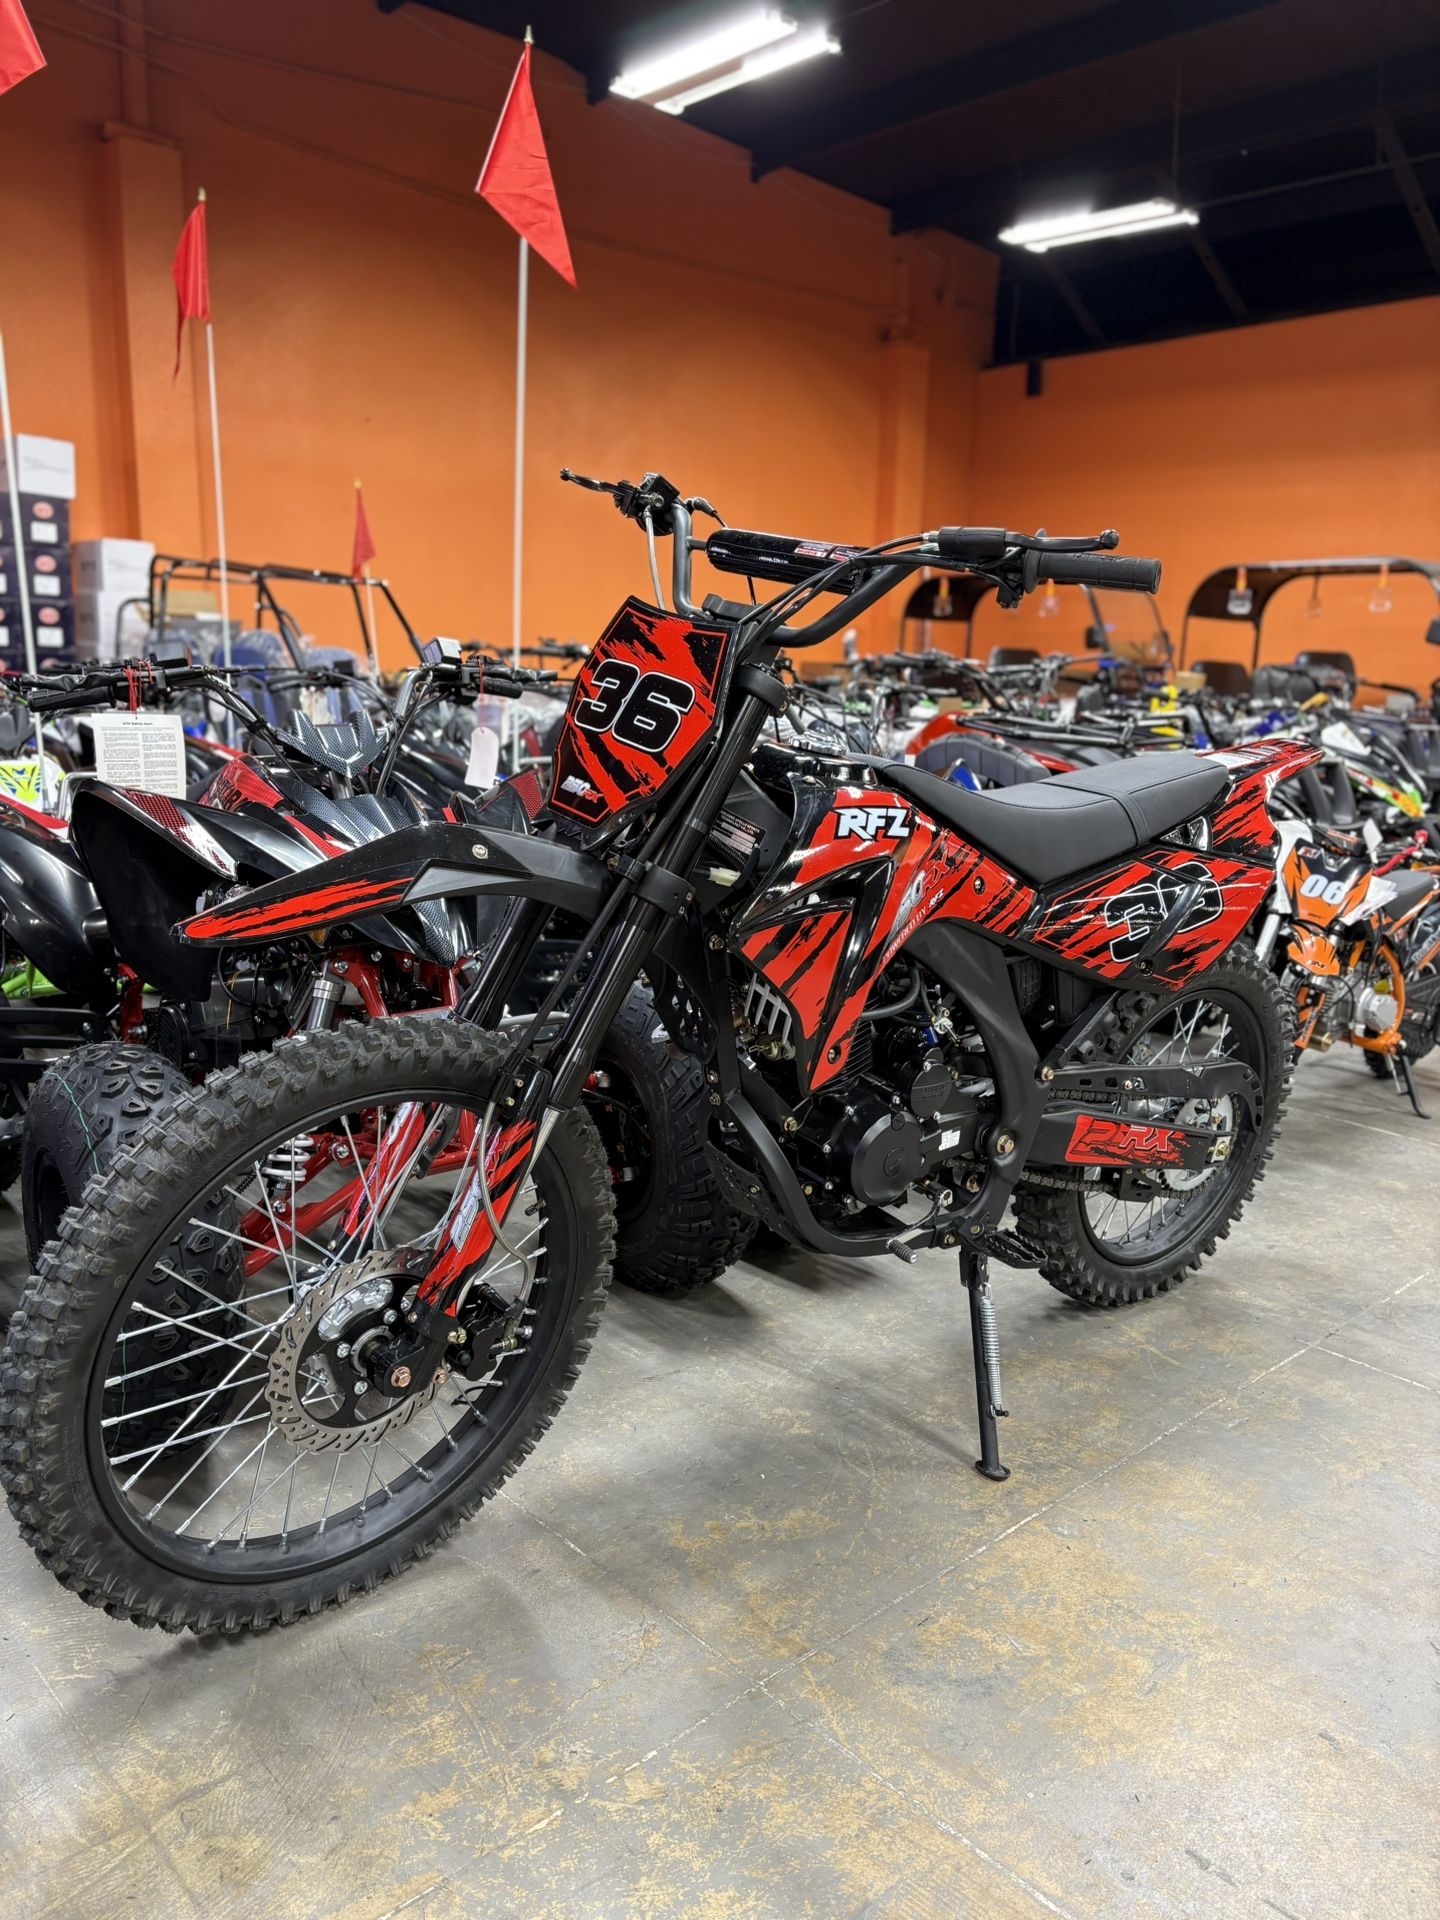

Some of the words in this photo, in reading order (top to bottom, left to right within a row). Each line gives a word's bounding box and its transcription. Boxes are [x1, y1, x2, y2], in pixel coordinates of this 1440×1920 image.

[574, 658, 695, 752] 36
[833, 807, 910, 840] RFZ
[1300, 873, 1347, 906] 06
[915, 906, 927, 922] BY
